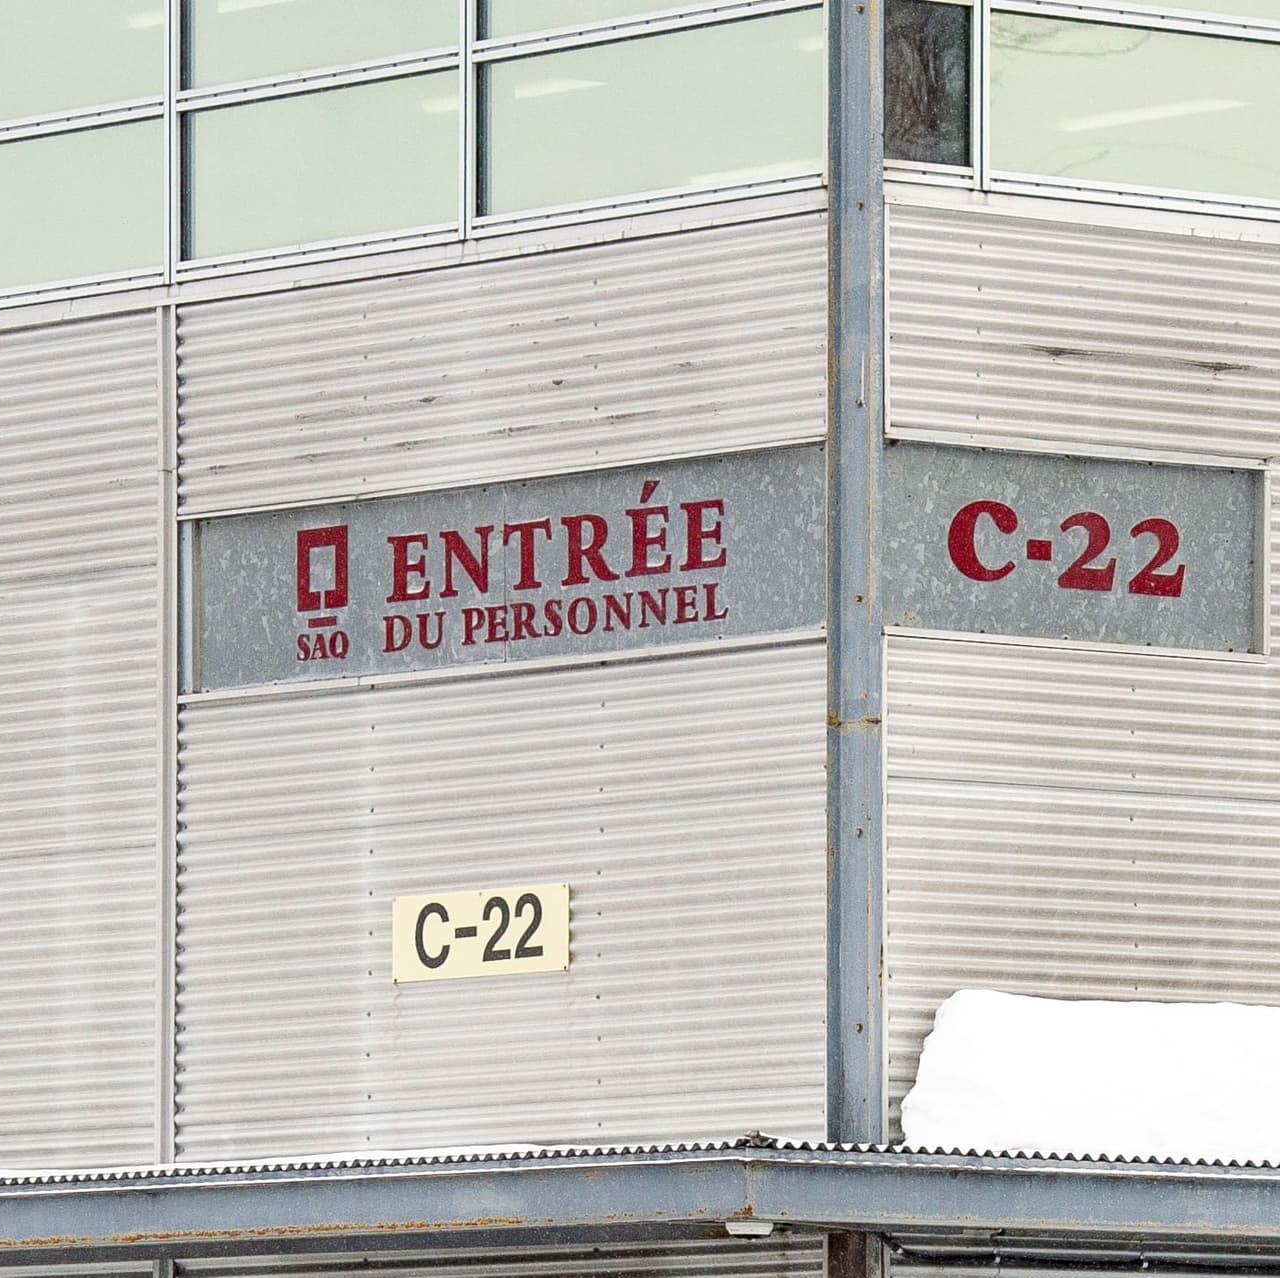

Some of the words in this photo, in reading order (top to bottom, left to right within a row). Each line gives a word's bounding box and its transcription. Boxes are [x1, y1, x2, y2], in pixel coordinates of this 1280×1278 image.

[386, 480, 729, 604] ENTRÉE
[947, 499, 1187, 598] C-22
[296, 630, 350, 662] SAQ
[382, 611, 447, 653] DU
[460, 582, 729, 647] PERSONNEL
[414, 892, 544, 969] C-22
